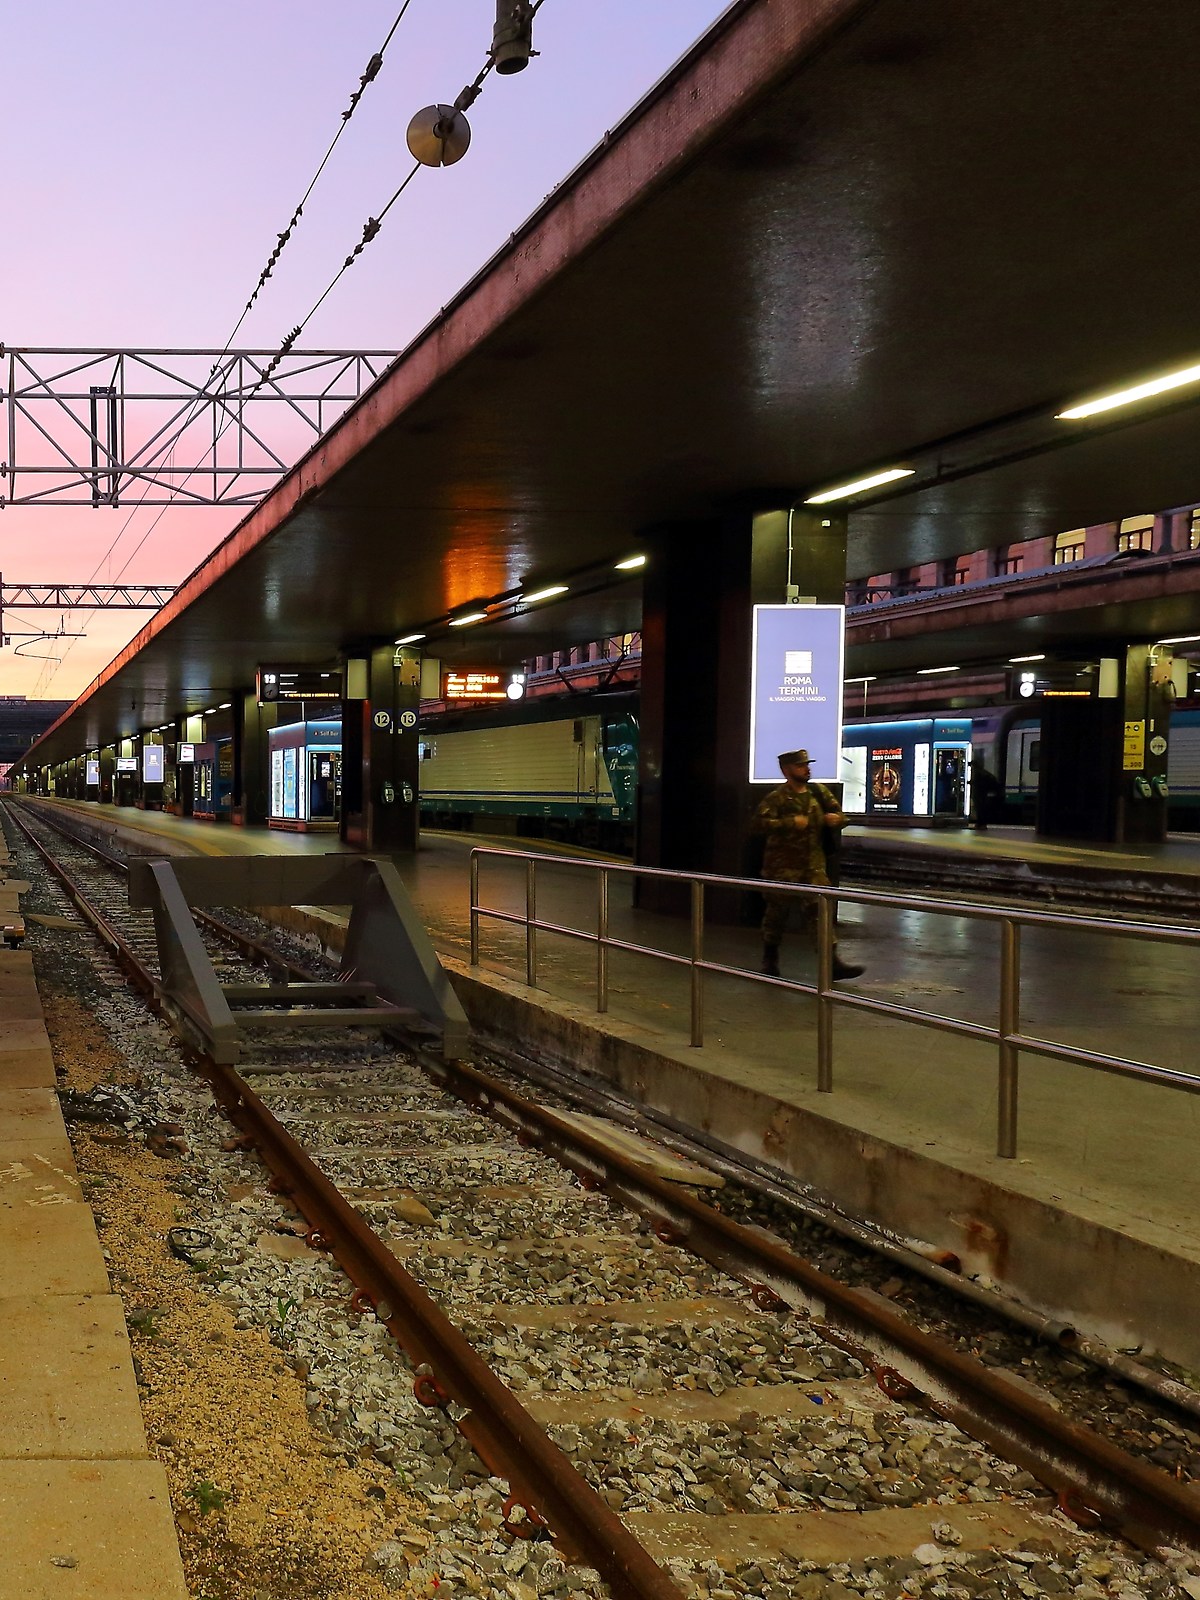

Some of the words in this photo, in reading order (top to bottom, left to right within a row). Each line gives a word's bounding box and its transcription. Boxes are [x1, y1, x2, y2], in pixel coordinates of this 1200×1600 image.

[784, 676, 812, 685] ROMA
[778, 686, 819, 695] TERMINI
[376, 714, 388, 724] 12
[403, 714, 414, 724] 13
